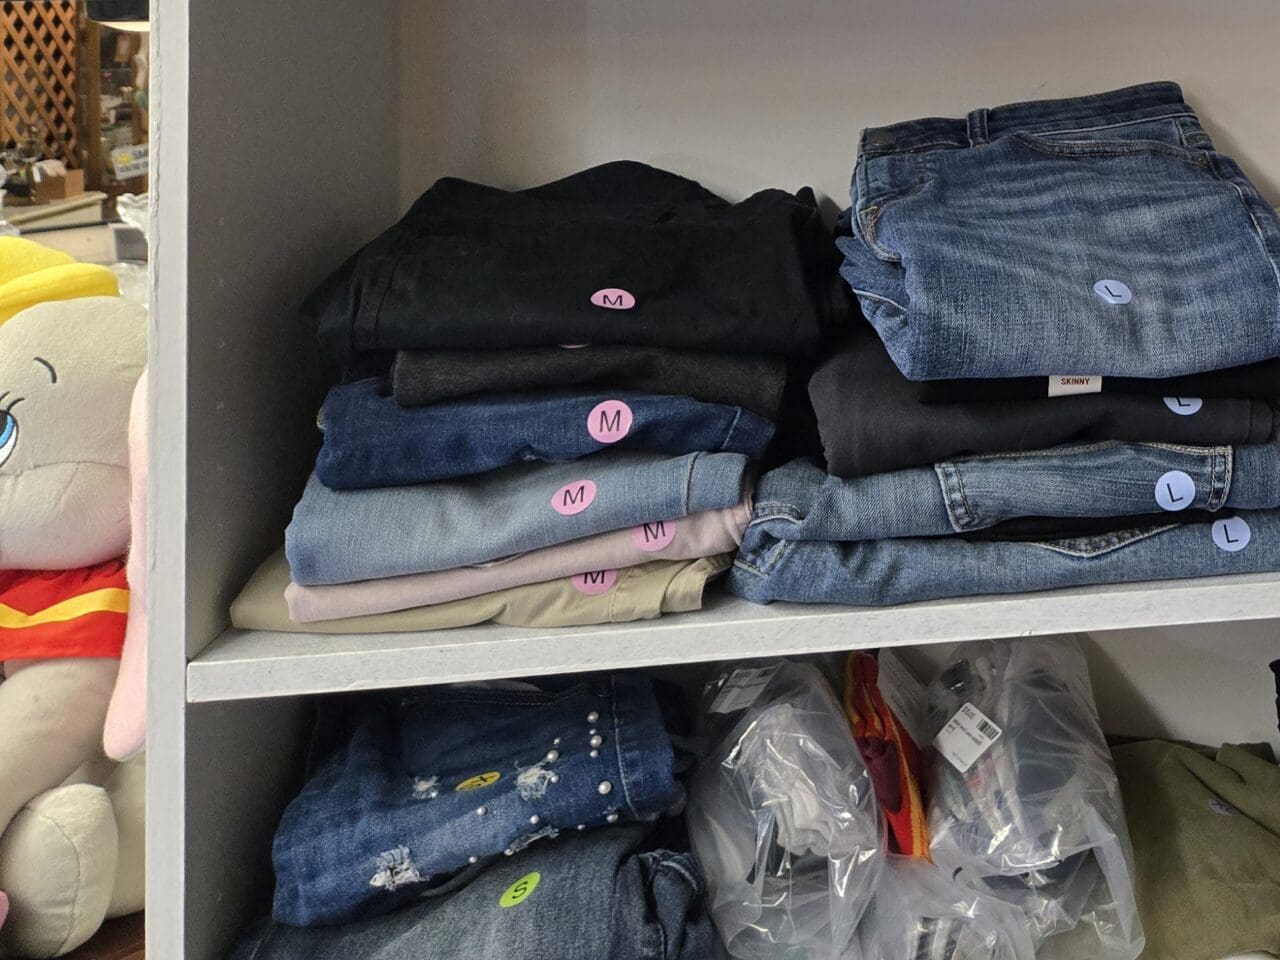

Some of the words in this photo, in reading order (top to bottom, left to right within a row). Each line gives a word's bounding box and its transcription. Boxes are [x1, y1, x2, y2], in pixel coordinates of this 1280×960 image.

[1104, 285, 1122, 297] L
[603, 294, 623, 307] M
[1061, 377, 1090, 386] SKINNY
[1175, 396, 1191, 407] L
[599, 410, 622, 433] M
[562, 486, 585, 507] M
[1167, 483, 1184, 502] L
[643, 520, 666, 542] M
[1223, 524, 1239, 543] L
[583, 570, 606, 585] M
[512, 881, 529, 899] S
